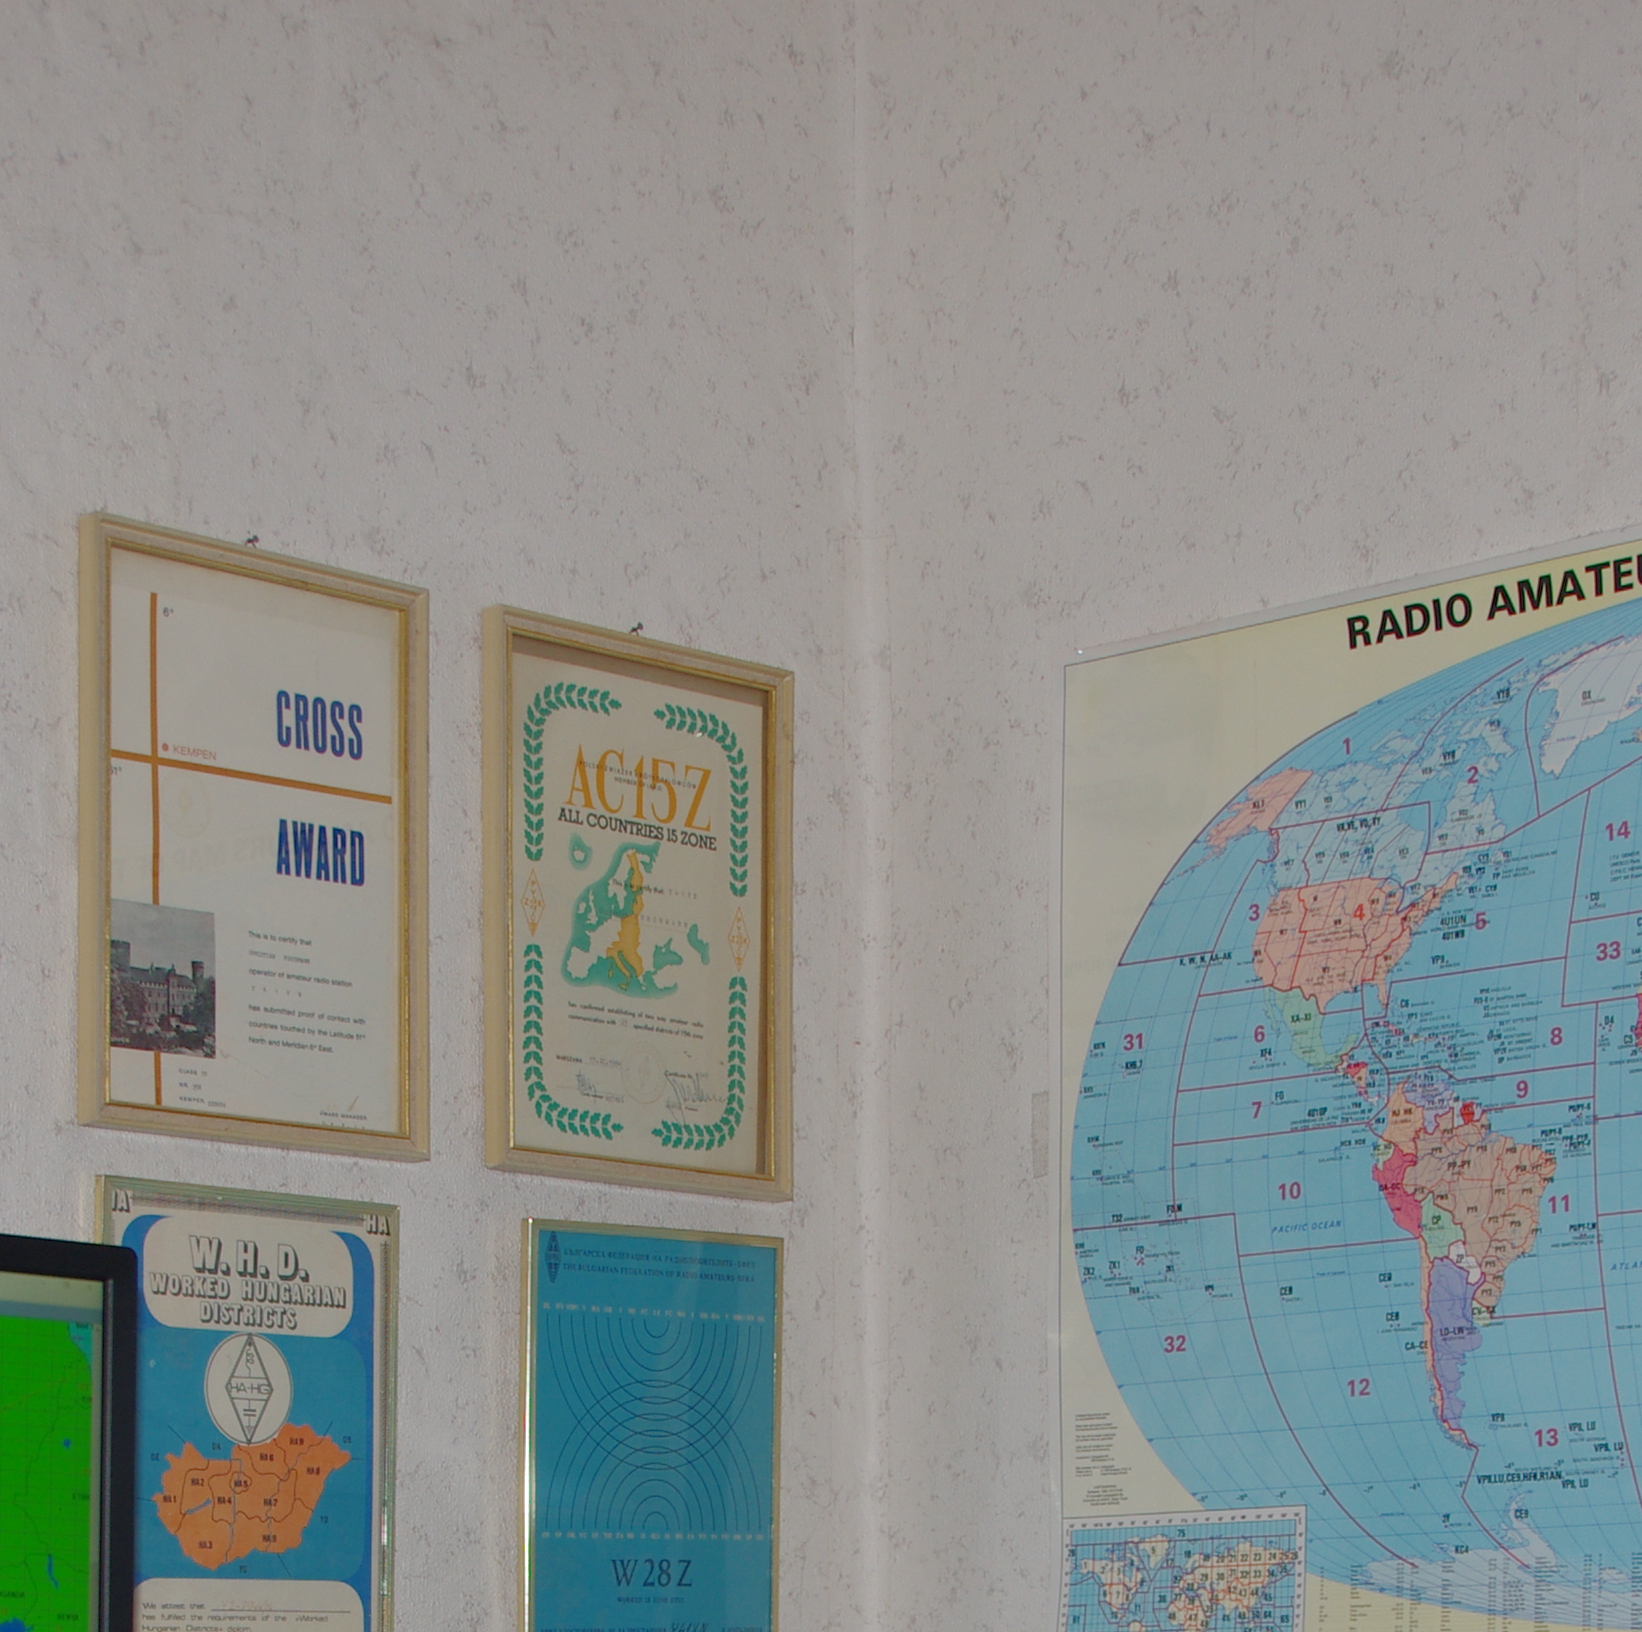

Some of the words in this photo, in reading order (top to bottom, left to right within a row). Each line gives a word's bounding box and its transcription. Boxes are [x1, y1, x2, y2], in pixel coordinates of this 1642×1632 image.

[1346, 593, 1473, 651] RADIO
[276, 689, 365, 761] CROSS
[172, 742, 217, 761] KEMPEN
[563, 744, 712, 832] AC15Z
[558, 808, 583, 825] ALL
[586, 812, 664, 840] COUNTRIES
[667, 829, 678, 842] 15
[680, 832, 717, 850] ZONE
[1605, 821, 1631, 842] 14
[276, 818, 366, 887] AWARD
[248, 931, 261, 939] This
[278, 936, 298, 945] certify
[249, 968, 277, 979] operator
[286, 972, 312, 982] amateur
[314, 975, 330, 984] radio
[331, 979, 352, 987] station
[1122, 1032, 1144, 1052] 31
[149, 1272, 231, 1299] WORKED
[241, 1279, 346, 1308] HUNGARIAN
[200, 1302, 297, 1329] DISTRICTS
[1163, 1334, 1187, 1354] 32
[230, 1383, 270, 1394] HA-HG
[1347, 1378, 1371, 1398] 12
